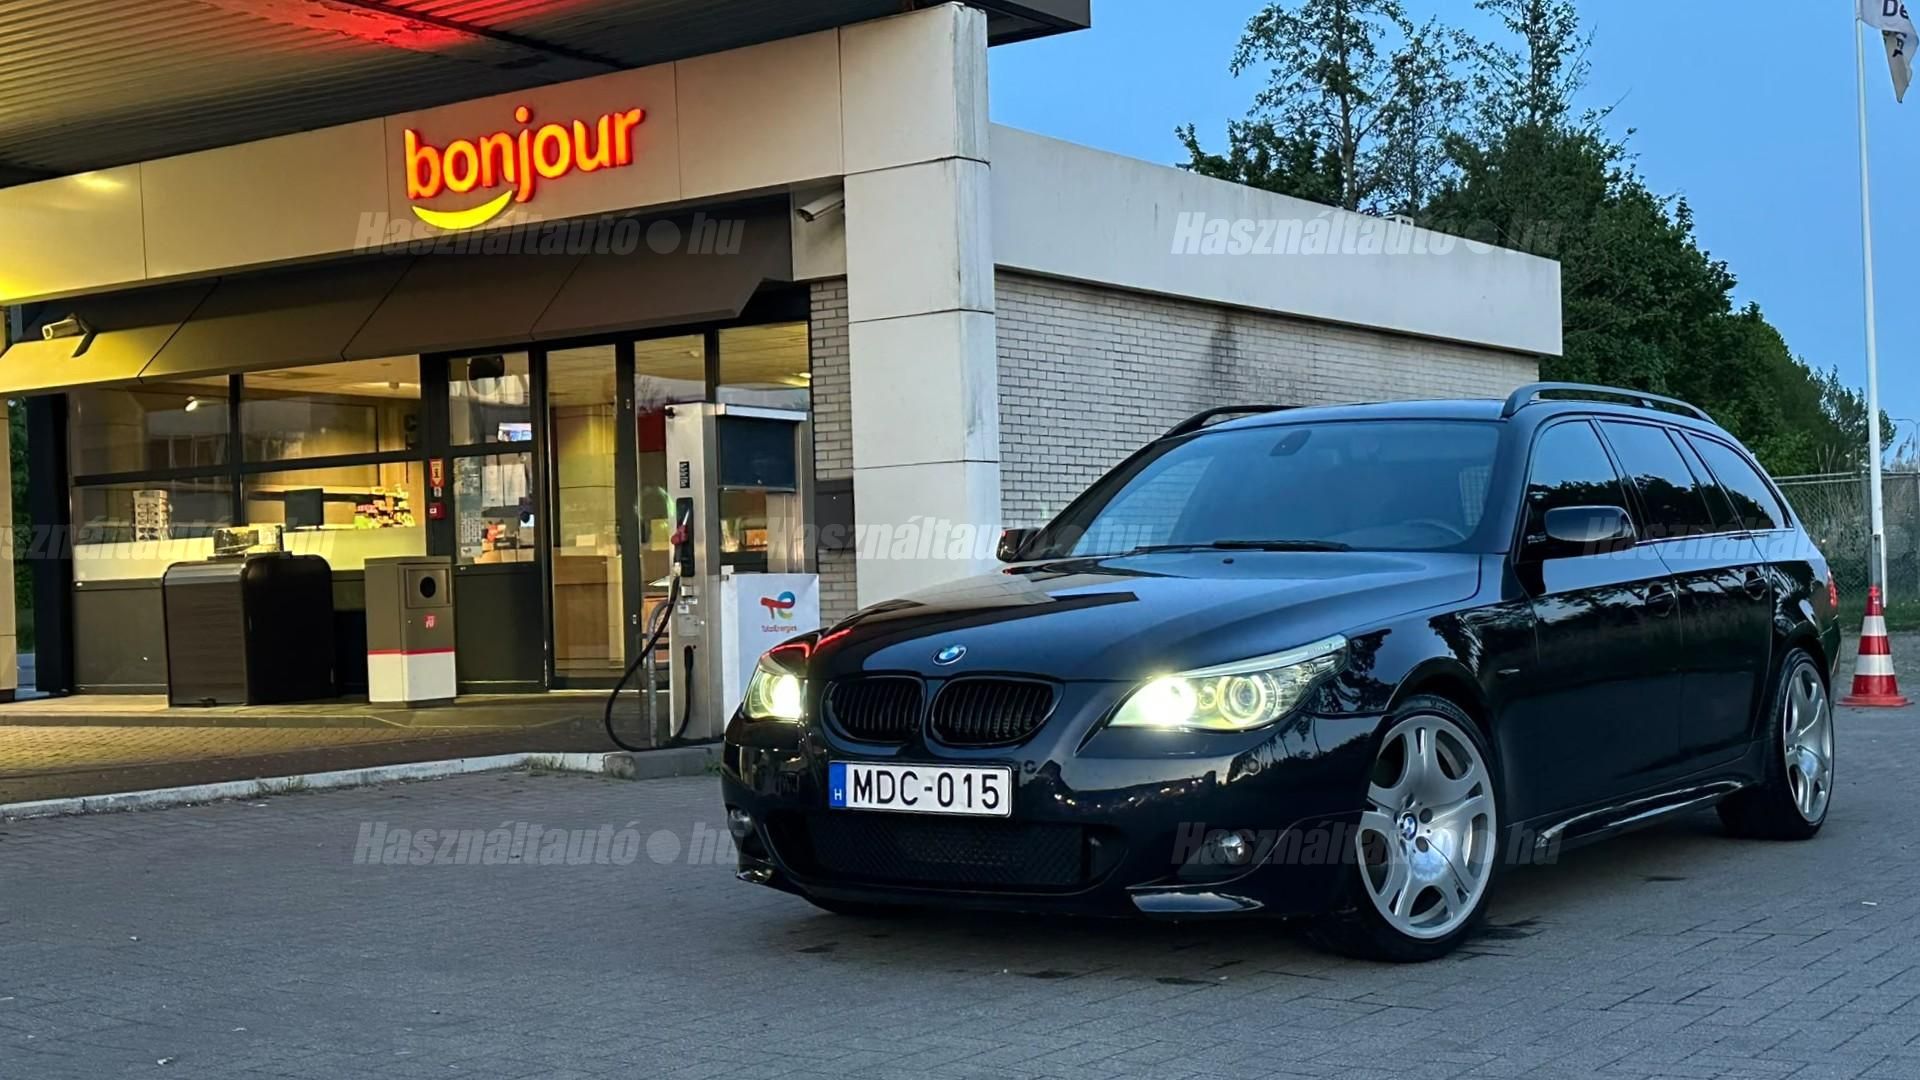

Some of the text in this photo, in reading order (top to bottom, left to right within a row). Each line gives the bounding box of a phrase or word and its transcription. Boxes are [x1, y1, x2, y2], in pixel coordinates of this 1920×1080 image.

[403, 105, 646, 203] bonjour
[834, 788, 843, 801] H
[853, 769, 1000, 810] MDC-015
